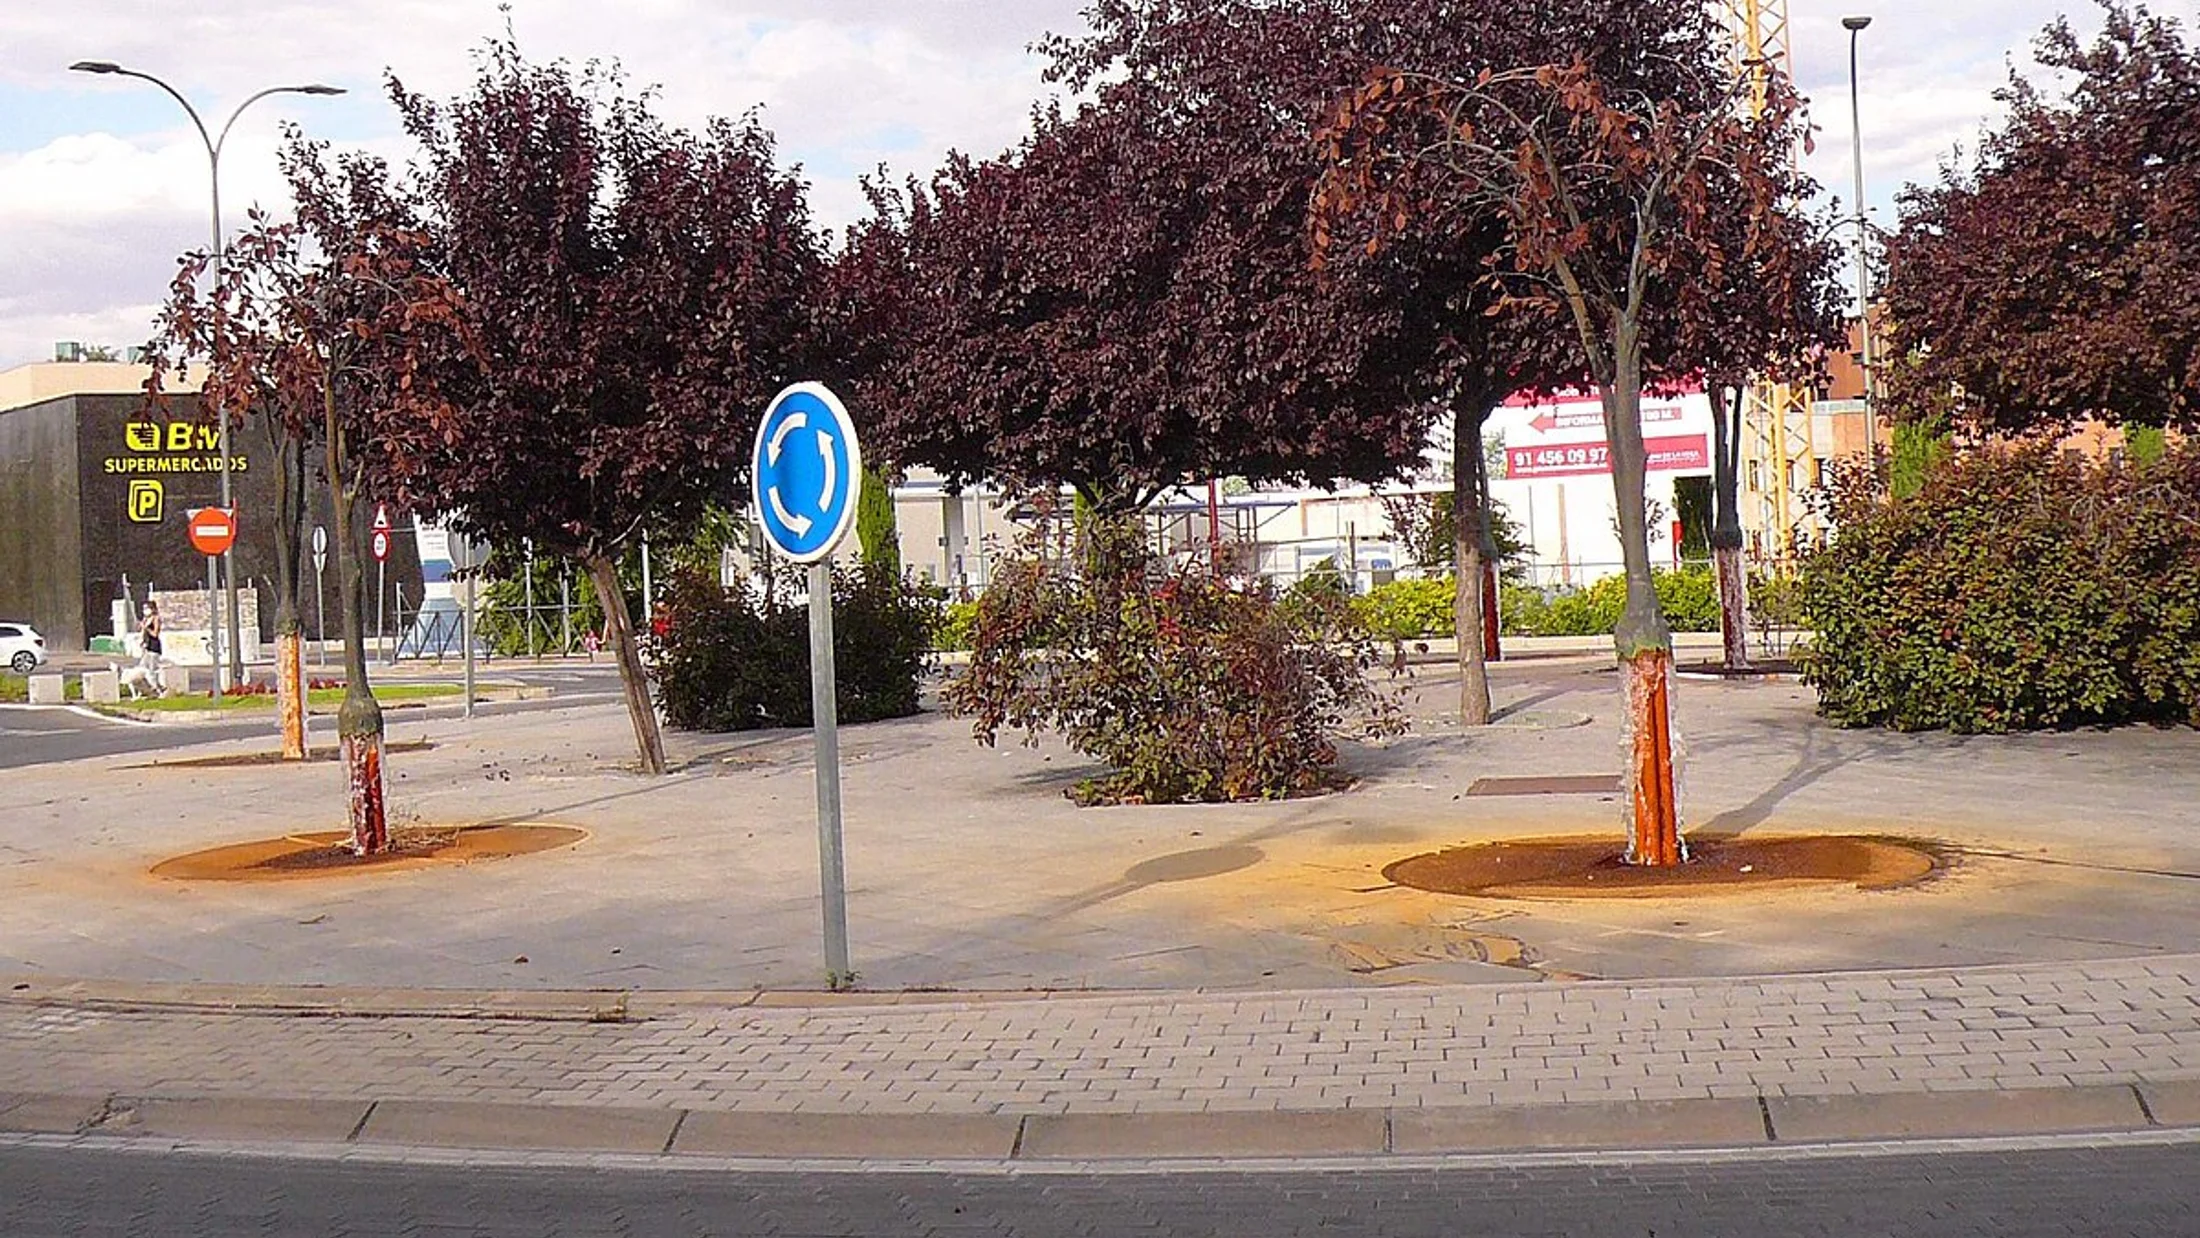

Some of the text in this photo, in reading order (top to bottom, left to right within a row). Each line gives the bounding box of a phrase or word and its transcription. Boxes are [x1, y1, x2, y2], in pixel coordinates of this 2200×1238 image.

[1514, 447, 1608, 466] 91 456 09 97
